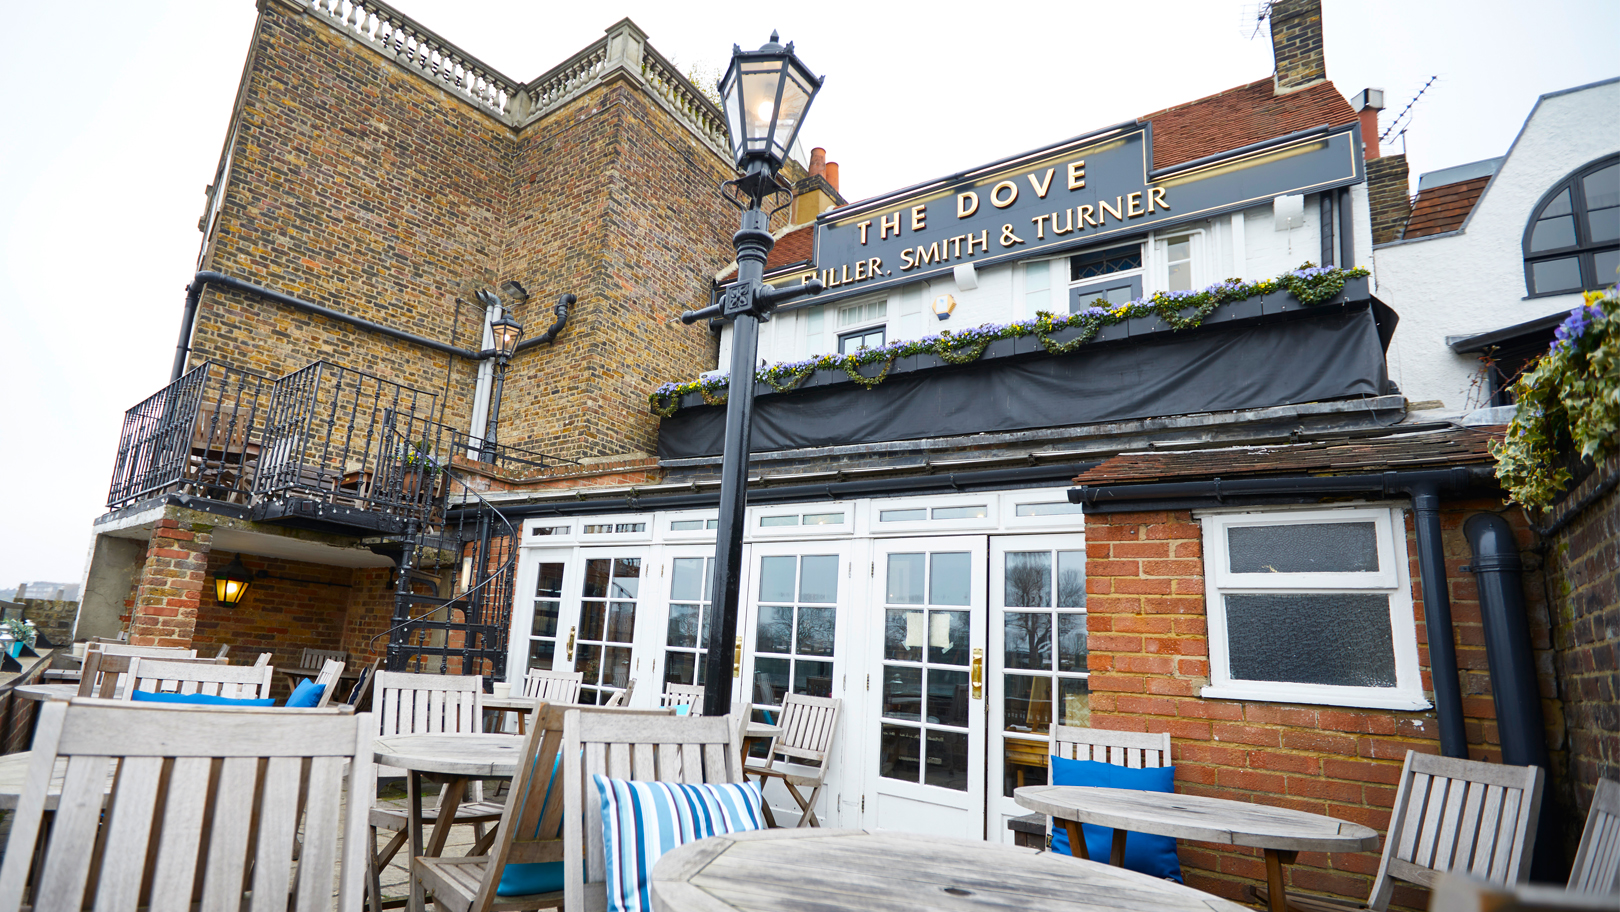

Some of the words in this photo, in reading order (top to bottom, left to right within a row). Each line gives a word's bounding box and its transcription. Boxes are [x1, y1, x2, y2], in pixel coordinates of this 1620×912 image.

[857, 204, 927, 246] THE
[957, 161, 1087, 219] DOVE
[900, 230, 989, 271] SMITH
[1000, 224, 1025, 248] &
[1031, 187, 1171, 240] TURNER
